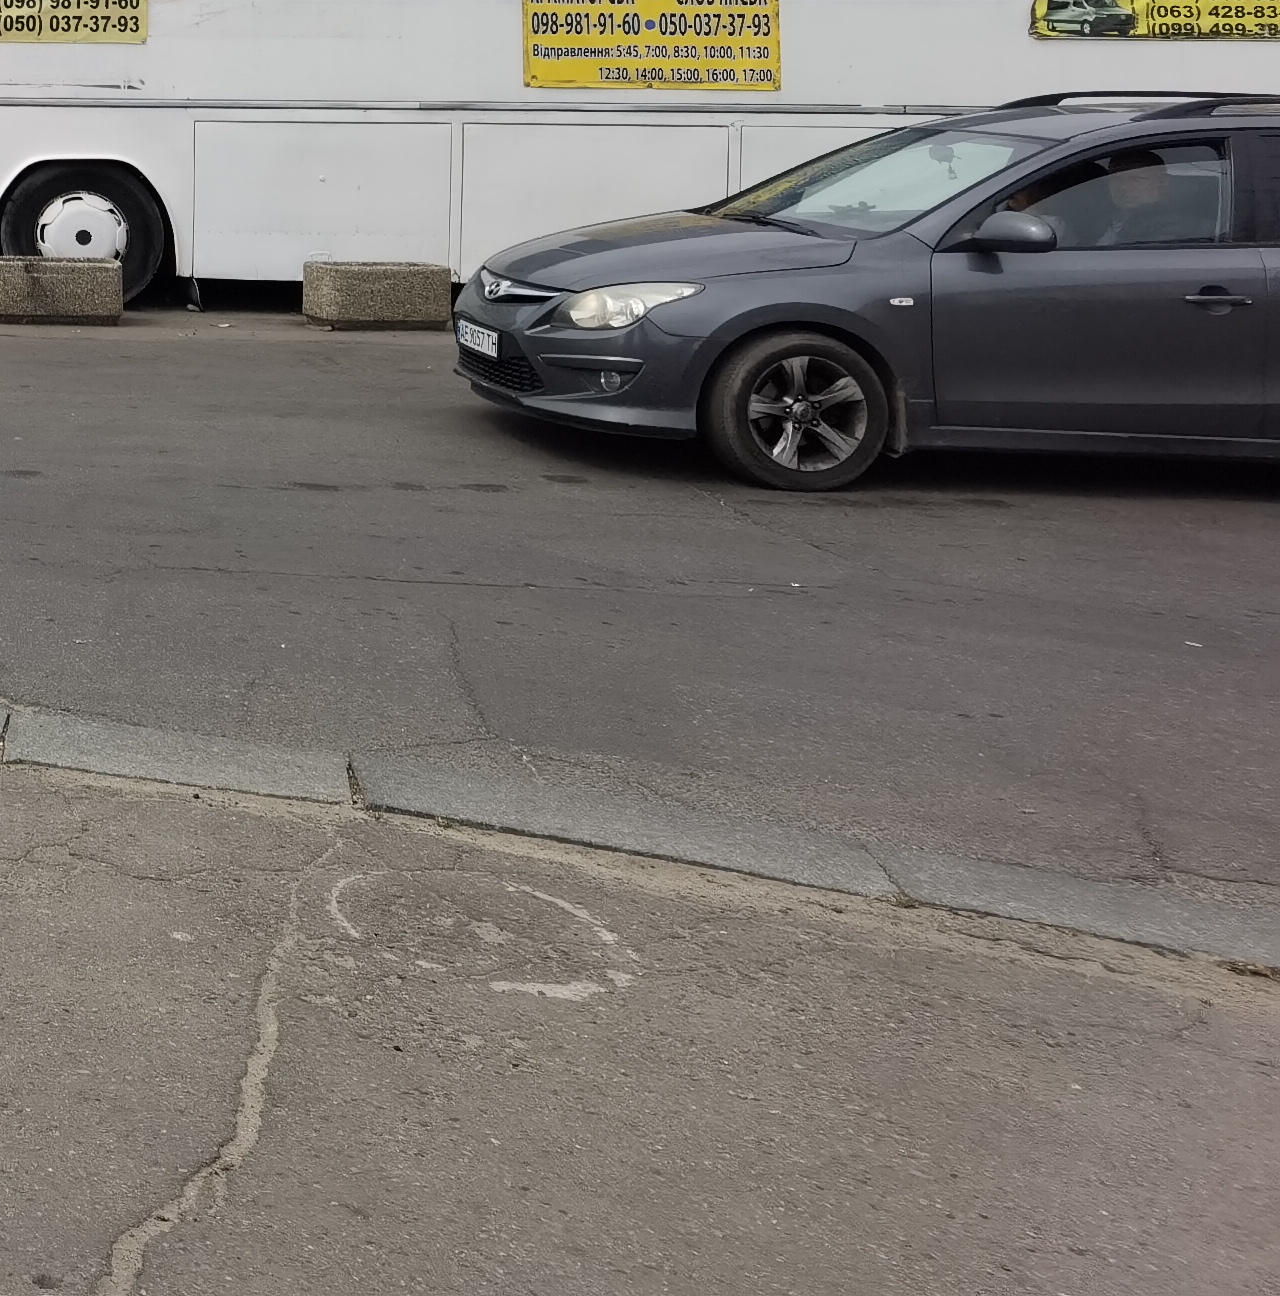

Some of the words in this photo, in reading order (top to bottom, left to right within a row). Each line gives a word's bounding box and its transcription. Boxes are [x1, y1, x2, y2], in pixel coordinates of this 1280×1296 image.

[1151, 5, 1201, 21] (063)
[50, 15, 140, 33] 037-37-93
[531, 12, 641, 36] 098-981-91-60
[658, 12, 772, 37] 050-037-37-93
[532, 43, 614, 60] Відправлення:
[644, 45, 671, 60] 7:00,
[673, 45, 701, 60] 8:30,
[703, 46, 736, 60] 10:00,
[739, 46, 770, 59] 11:30
[598, 67, 632, 82] 12:30,
[706, 68, 739, 83] 16:00,
[742, 68, 773, 81] 17:00
[486, 333, 497, 354] TH
